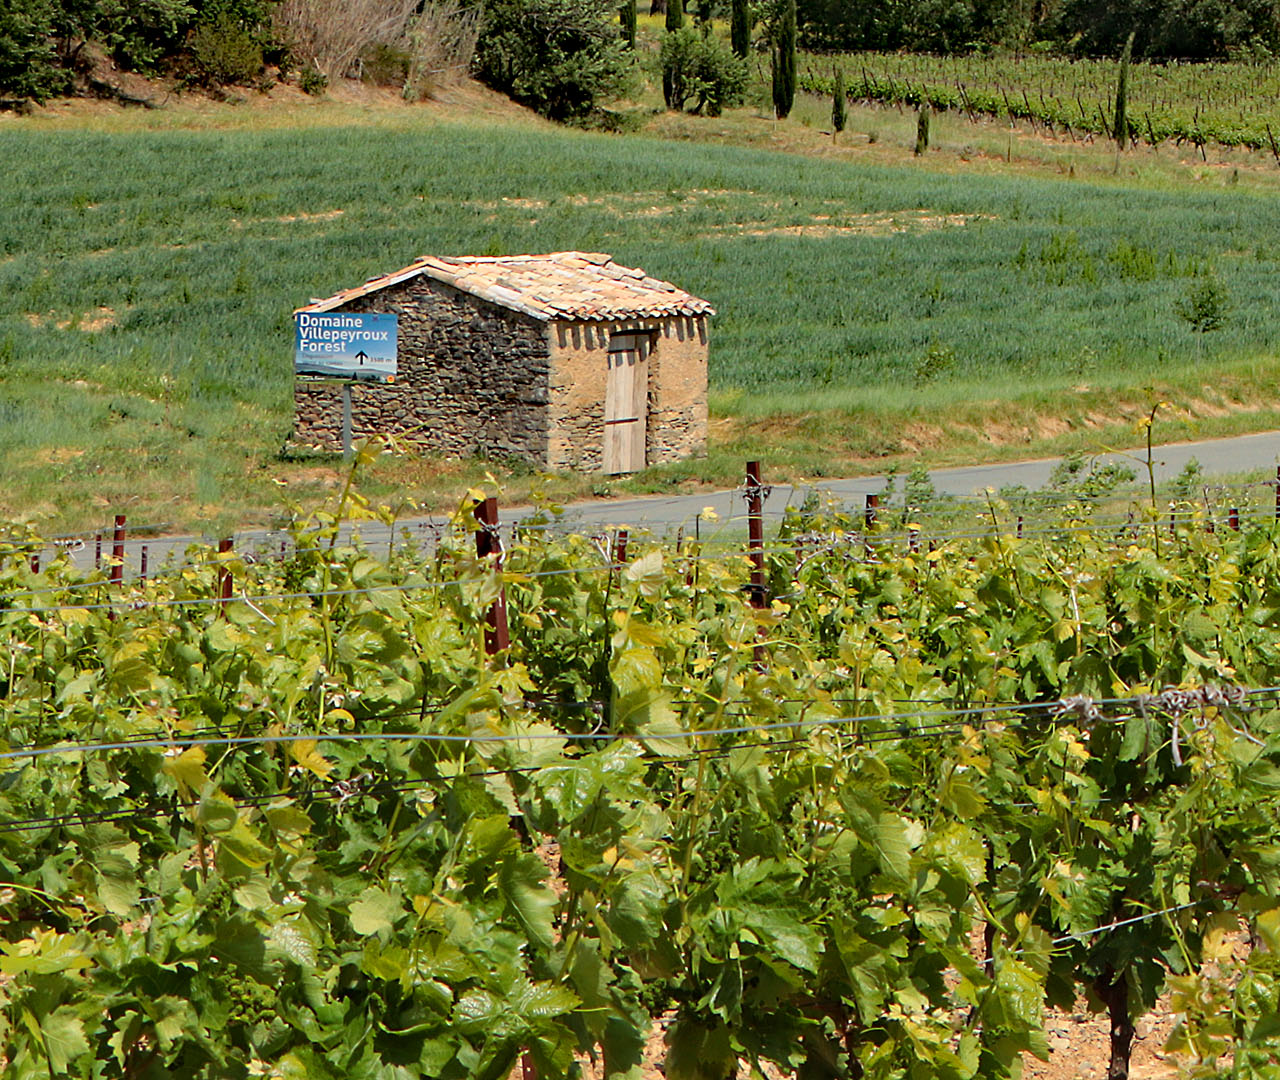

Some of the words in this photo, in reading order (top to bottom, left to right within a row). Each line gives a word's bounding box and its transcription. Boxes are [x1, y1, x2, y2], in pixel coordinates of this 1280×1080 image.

[300, 314, 363, 328] Domaine
[299, 327, 388, 342] Villepeyroux
[300, 340, 346, 352] Forest
